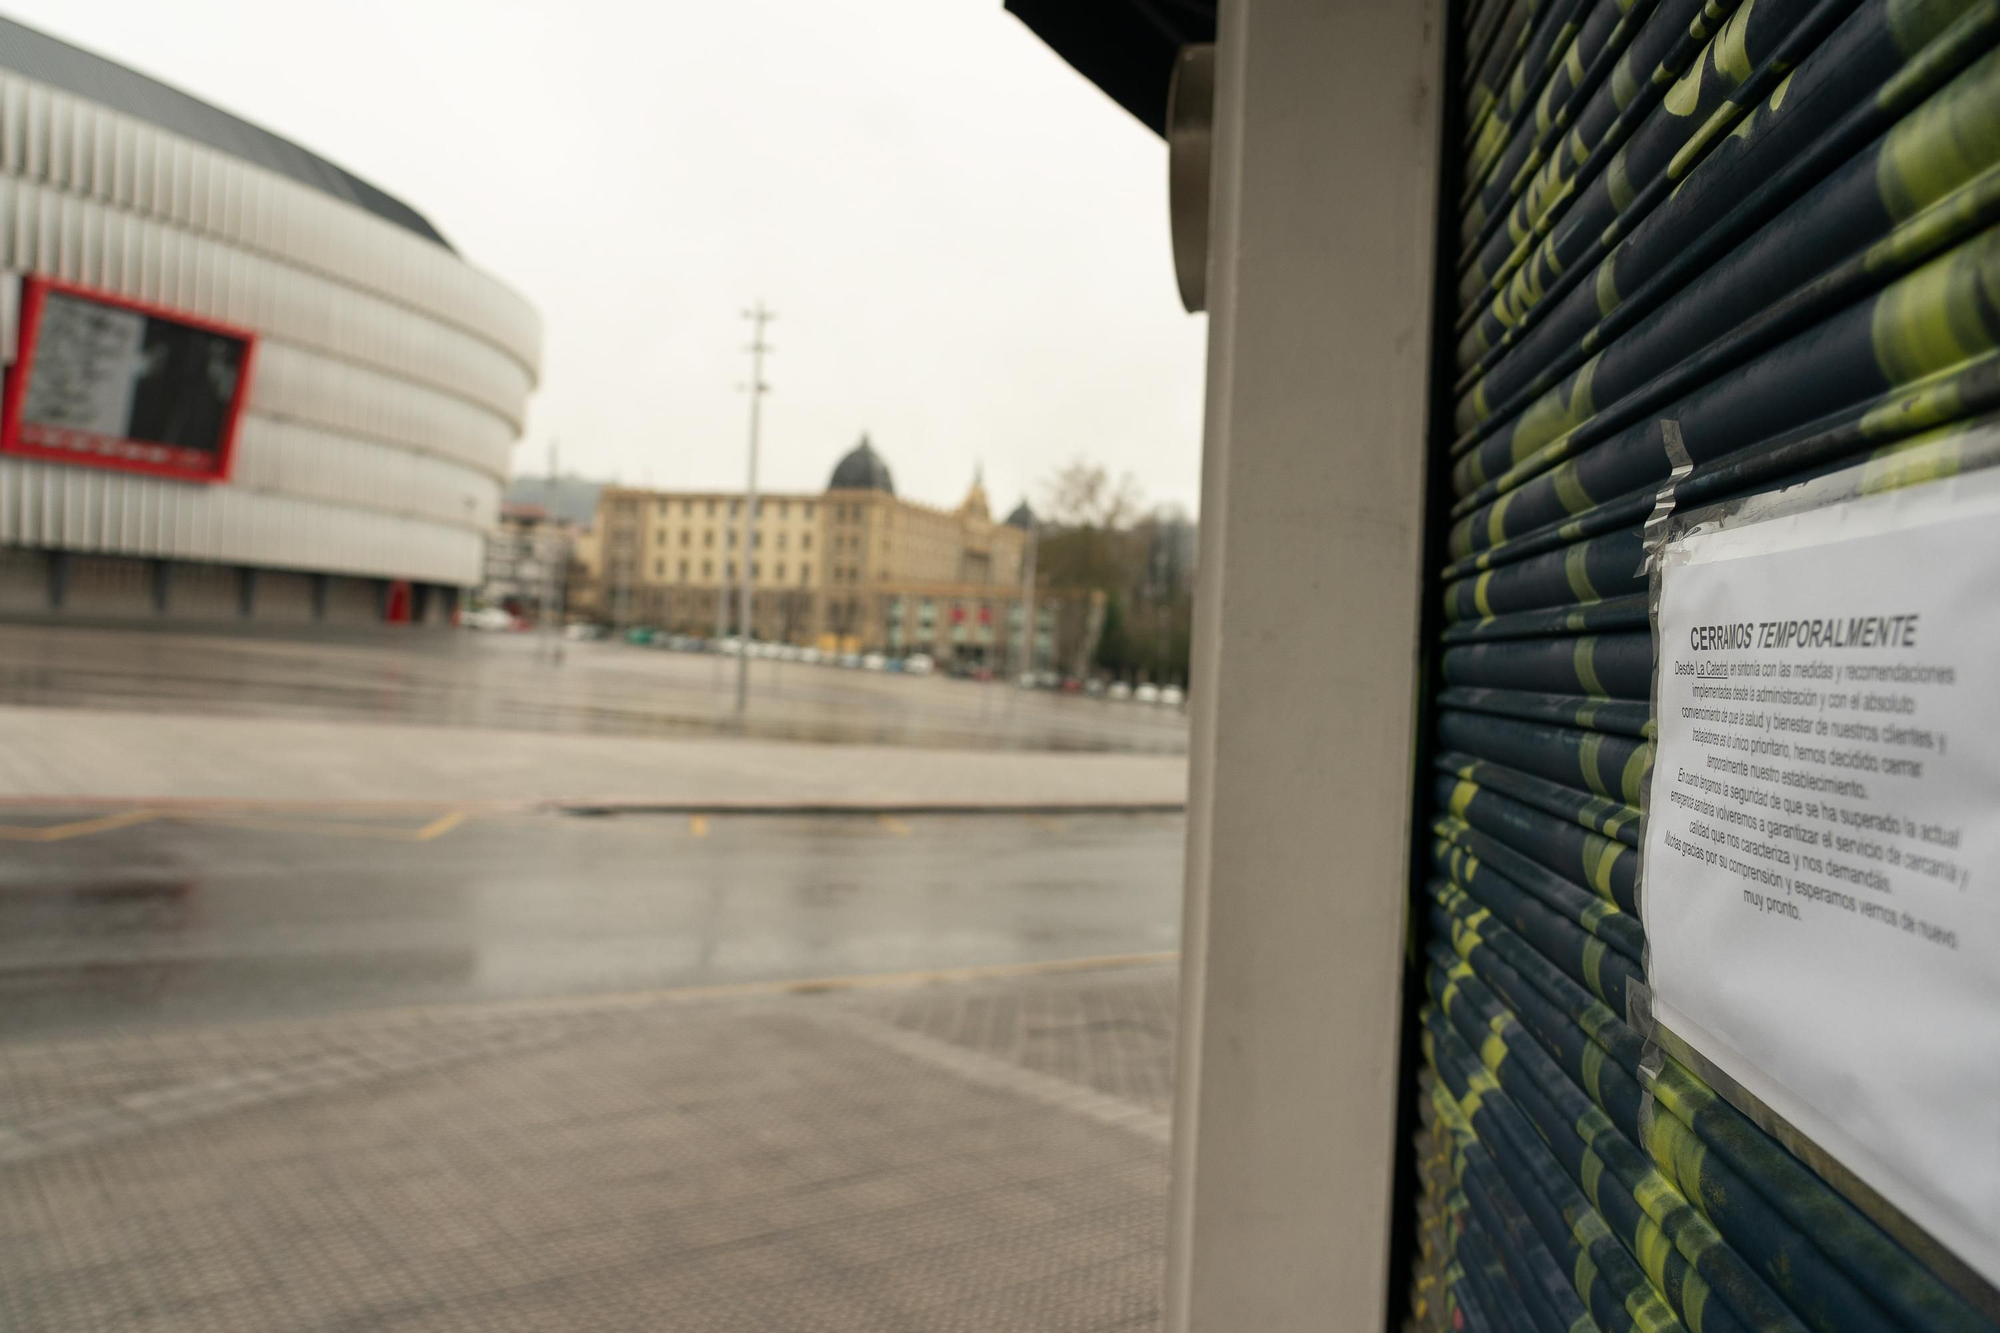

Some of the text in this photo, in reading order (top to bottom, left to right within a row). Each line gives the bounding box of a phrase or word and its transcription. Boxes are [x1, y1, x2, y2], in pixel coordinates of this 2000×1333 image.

[1691, 614, 1918, 651] CERRAMOS TEMPORALMENTE
[1675, 661, 1695, 676] Desde
[1696, 661, 1705, 676] La
[1730, 664, 1737, 677] en
[1738, 660, 1760, 677] sintonía
[1762, 663, 1777, 677] con
[1779, 660, 1791, 678] las
[1793, 660, 1833, 679] medidas
[1835, 666, 1842, 685] y
[1845, 663, 1955, 685] recomendaciones
[1692, 682, 1917, 715] implementadas desde la administración y con el absoluto
[1681, 706, 1720, 722] convencimiento
[1721, 708, 1728, 723] de
[1728, 711, 1738, 727] que
[1739, 710, 1744, 725] la
[1745, 711, 1763, 728] salud
[1765, 715, 1772, 733] y
[1773, 712, 1813, 735] bienestar
[1815, 716, 1828, 736] de
[1830, 721, 1879, 742] nuestros
[1881, 723, 1934, 750] clientes
[1692, 727, 1719, 746] trabajadores
[1719, 734, 1726, 747] es
[1727, 731, 1732, 748] lo
[1732, 733, 1749, 752] único
[1793, 741, 1826, 764] hemos
[1829, 747, 1879, 773] decidido
[1706, 753, 1869, 800] temporalmente nuestro establecimiento.
[1678, 767, 1962, 850] En cuanto tengamos la seguridad de que se ha superado la actual
[1670, 790, 1694, 809] emergencia
[1693, 798, 1715, 817] sanitaria
[1716, 804, 1758, 830] volveremos
[1759, 819, 1765, 832] a
[1767, 820, 1820, 845] garantizar
[1821, 830, 1833, 849] el
[1835, 835, 1883, 861] servicio
[1886, 843, 1901, 866] de
[1959, 868, 1970, 894] y
[1689, 820, 1710, 839] calidad
[1711, 828, 1726, 845] que
[1727, 833, 1740, 849] nos
[1741, 838, 1791, 865] caracteriza
[1793, 853, 1800, 872] y
[1802, 855, 1822, 875] nos
[1664, 830, 1681, 852] Muchas
[1682, 840, 1704, 861] gracias
[1706, 848, 1718, 866] por
[1719, 855, 1728, 869] su
[1729, 858, 1783, 889] comprensión
[1785, 877, 1792, 896] y
[1795, 880, 1857, 913] esperamos
[1901, 909, 1915, 934] de
[1744, 889, 1764, 912] muy
